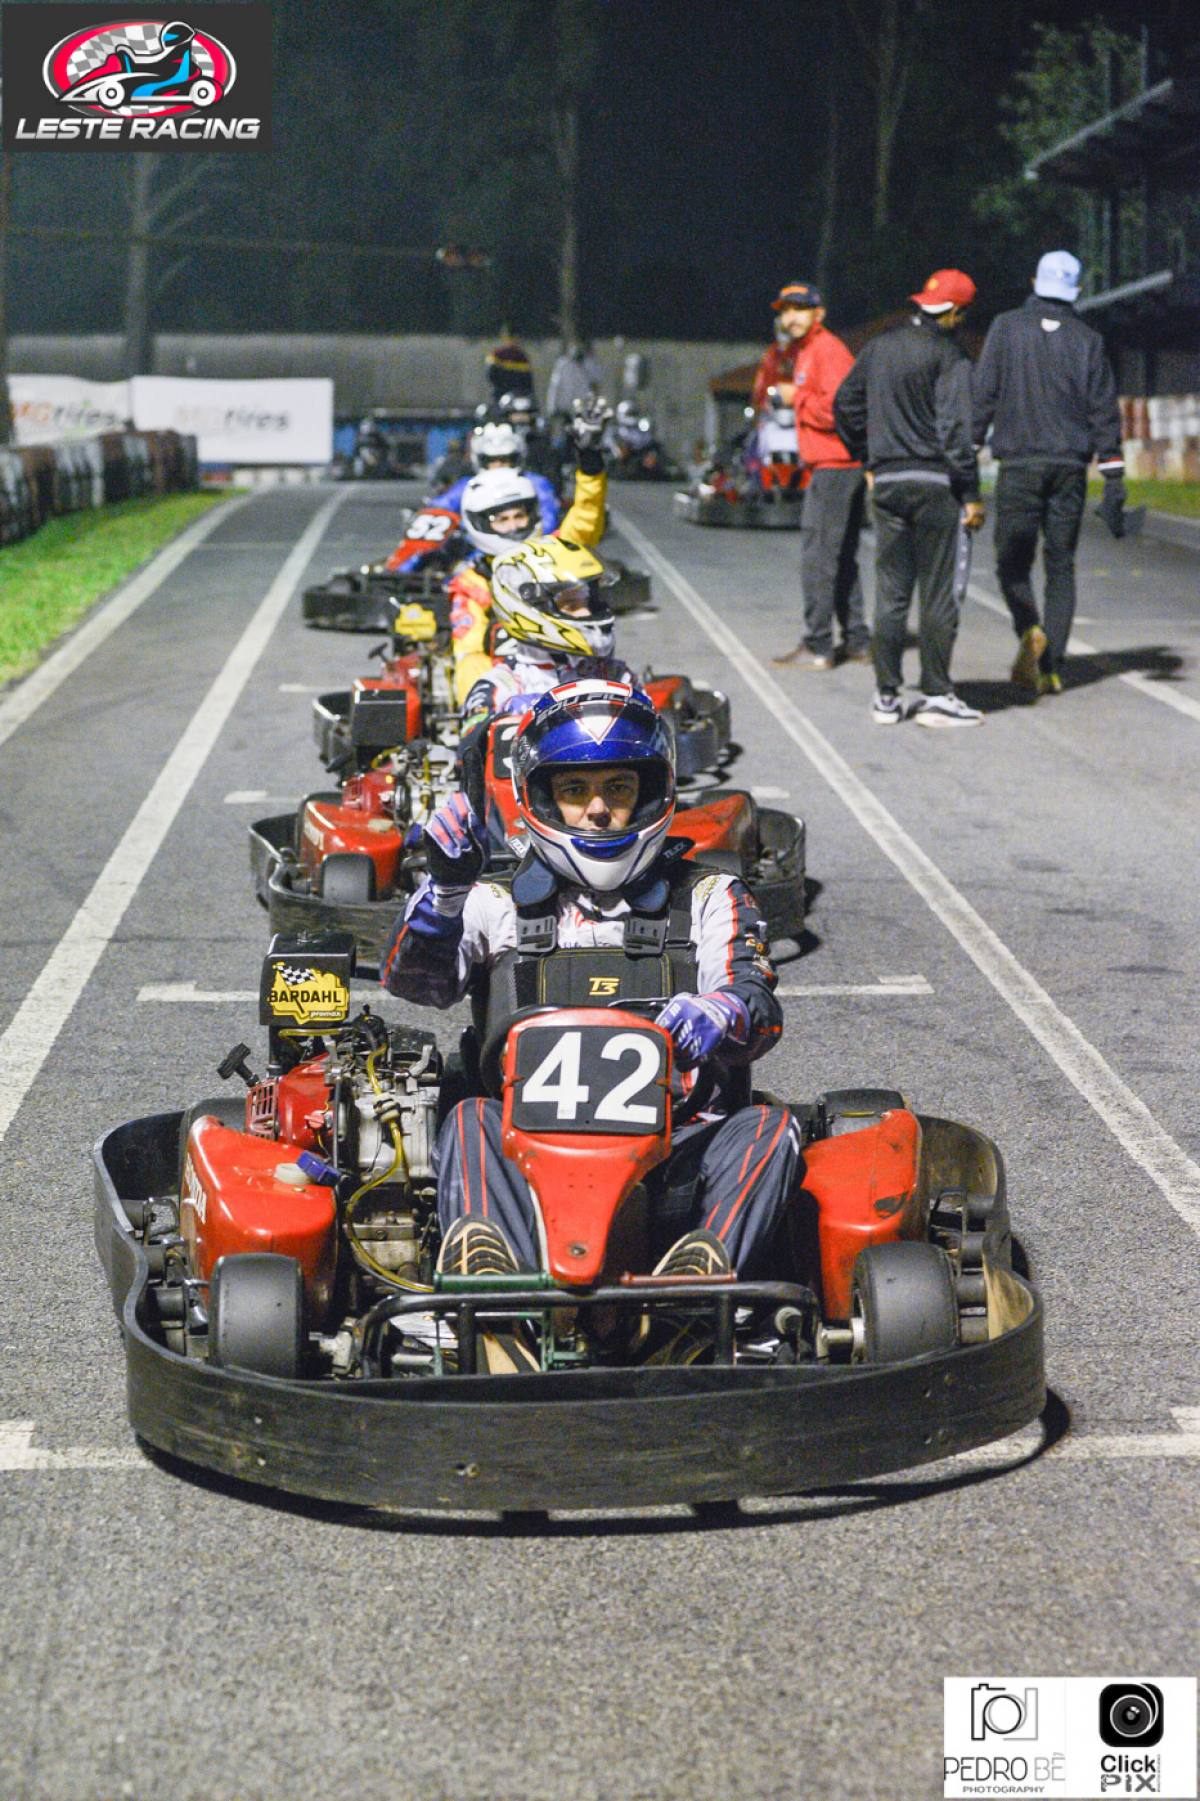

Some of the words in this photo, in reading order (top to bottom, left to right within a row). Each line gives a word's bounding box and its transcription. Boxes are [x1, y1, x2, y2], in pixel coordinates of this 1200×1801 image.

[589, 977, 620, 996] T3
[269, 990, 342, 1003] BARDAHL
[521, 1031, 661, 1124] 42
